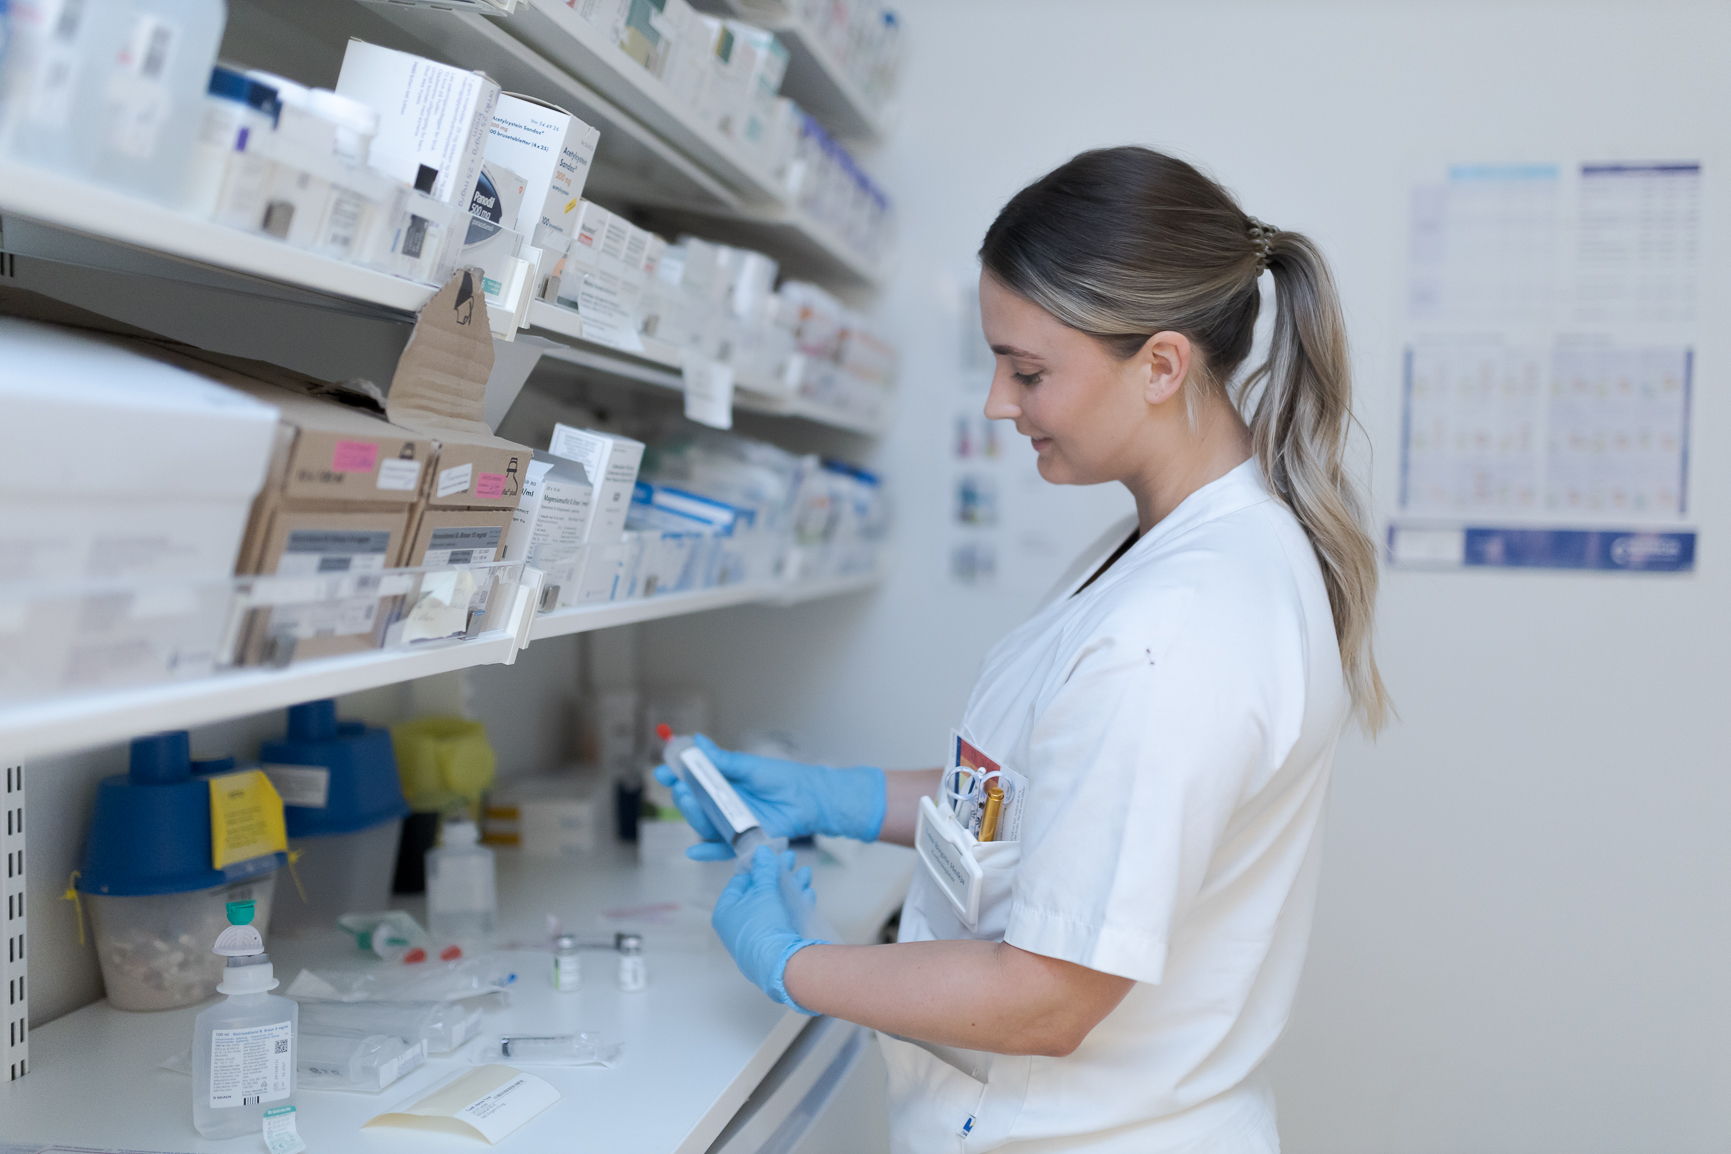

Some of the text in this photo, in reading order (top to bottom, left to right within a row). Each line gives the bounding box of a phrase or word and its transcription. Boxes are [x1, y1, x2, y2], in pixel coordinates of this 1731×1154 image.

[467, 167, 474, 179] 25
[458, 181, 469, 207] mg/g
[474, 191, 496, 209] Panodil
[470, 203, 483, 216] 500
